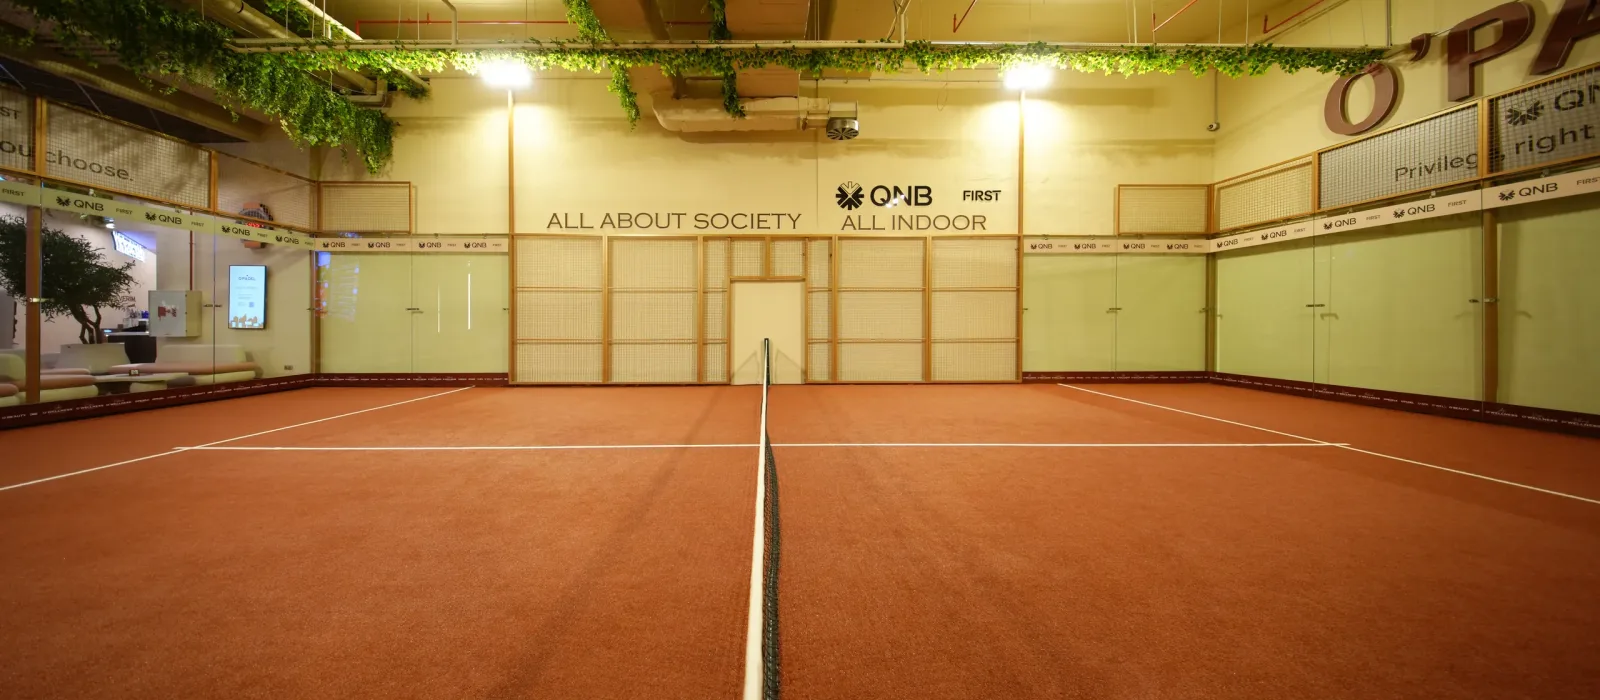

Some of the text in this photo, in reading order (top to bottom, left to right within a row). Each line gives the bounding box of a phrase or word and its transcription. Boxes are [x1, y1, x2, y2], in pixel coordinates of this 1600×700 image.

[1515, 124, 1595, 154] right
[45, 150, 134, 181] choose.
[2, 188, 25, 197] FIRST
[870, 185, 1001, 207] QNB FIRST
[1519, 183, 1558, 197] QNB
[73, 199, 104, 212] QNB
[115, 207, 133, 215] FIRST
[158, 214, 182, 225] QNB
[547, 212, 802, 230] ALL ABOUT SOCIETY
[1334, 218, 1357, 228] QNB
[1407, 204, 1436, 215] QNB
[841, 215, 987, 230] ALL INDOOR
[231, 227, 251, 236] QNB
[284, 236, 299, 245] QNB
[1223, 238, 1239, 247] QNB
[1269, 230, 1287, 239] QNB
